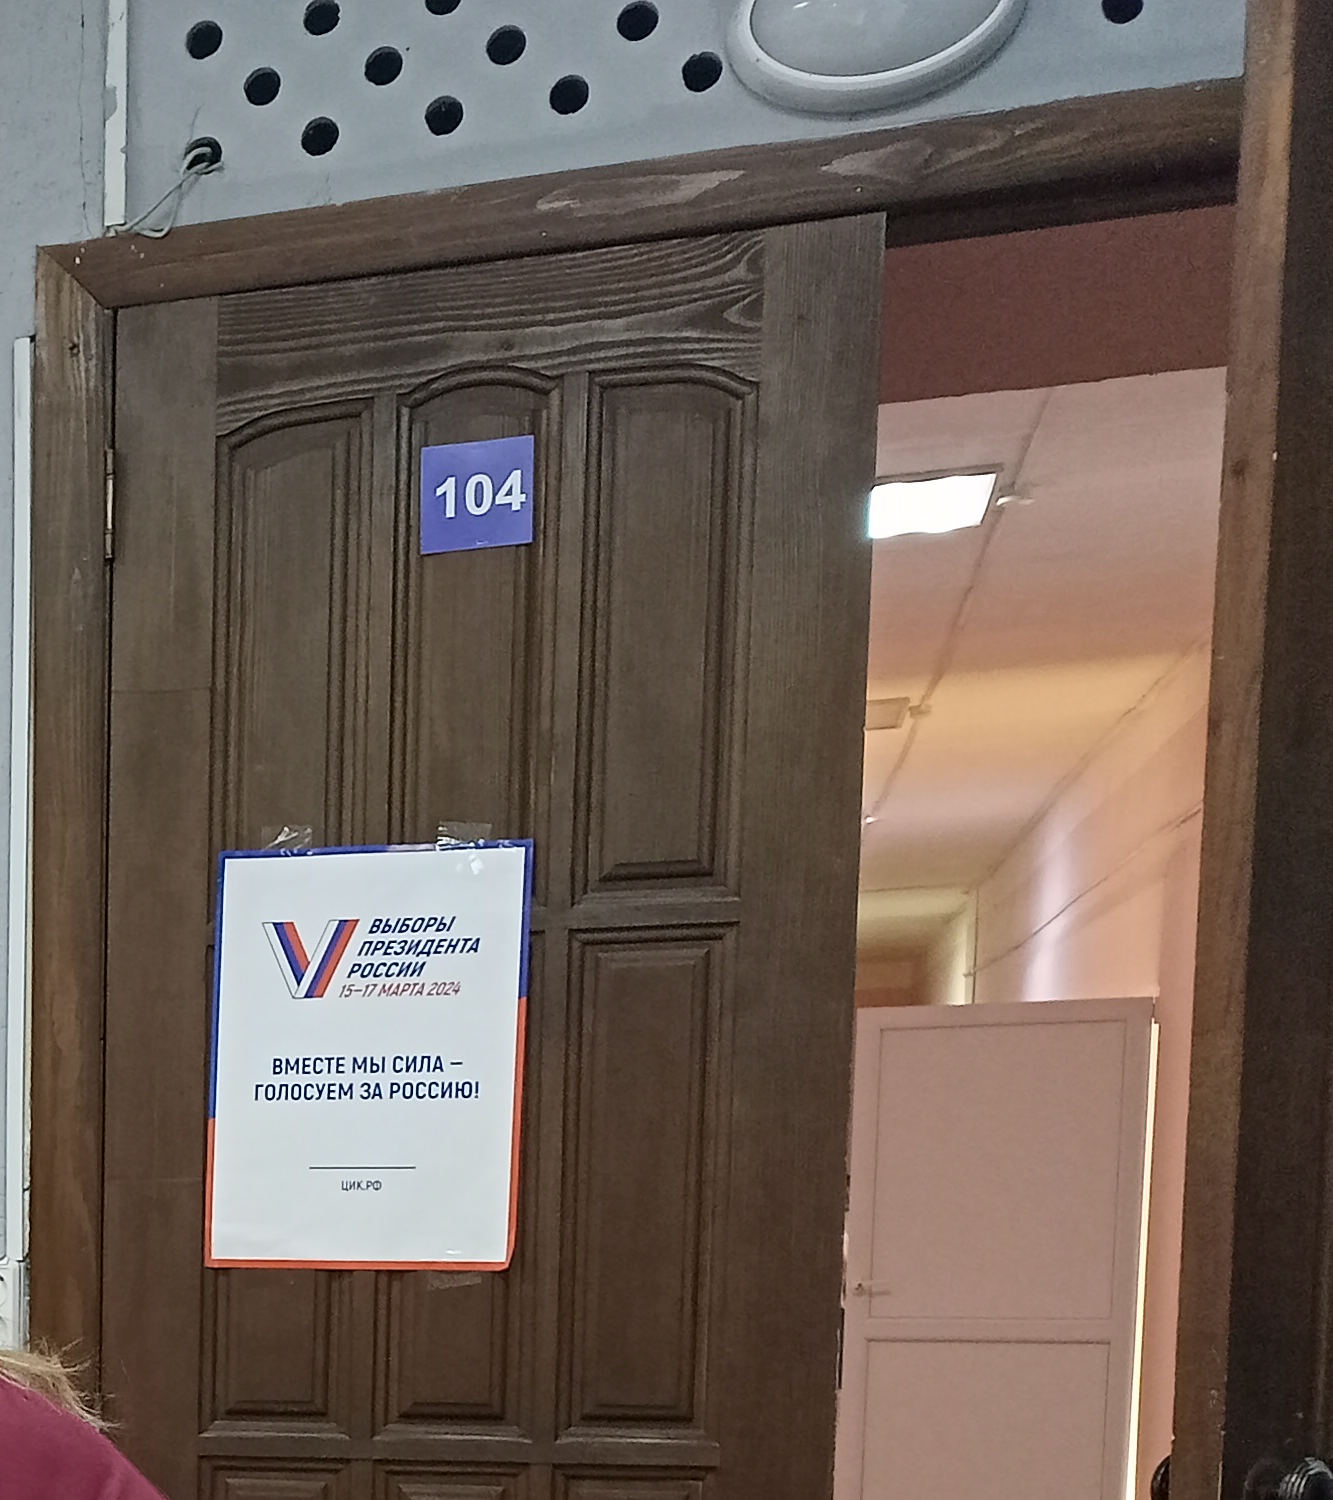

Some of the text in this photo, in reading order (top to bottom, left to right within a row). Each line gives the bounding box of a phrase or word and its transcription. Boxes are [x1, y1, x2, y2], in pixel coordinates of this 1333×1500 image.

[435, 469, 526, 518] 104
[368, 916, 456, 934] ВЫБОРЫ
[357, 938, 481, 957] ПРЕЗИДЕНТА
[346, 961, 426, 979] РОССИИ
[377, 982, 426, 997] МАРТА
[426, 981, 461, 996] 2024
[272, 1057, 345, 1075] ВМЕСТЕ
[351, 1056, 386, 1074] МЫ
[392, 1056, 444, 1073] СИЛА
[254, 1081, 480, 1101] ГОЛОСУЕМ ЗА РОССИЮ!
[341, 1180, 383, 1192] ЦИК.РФ
